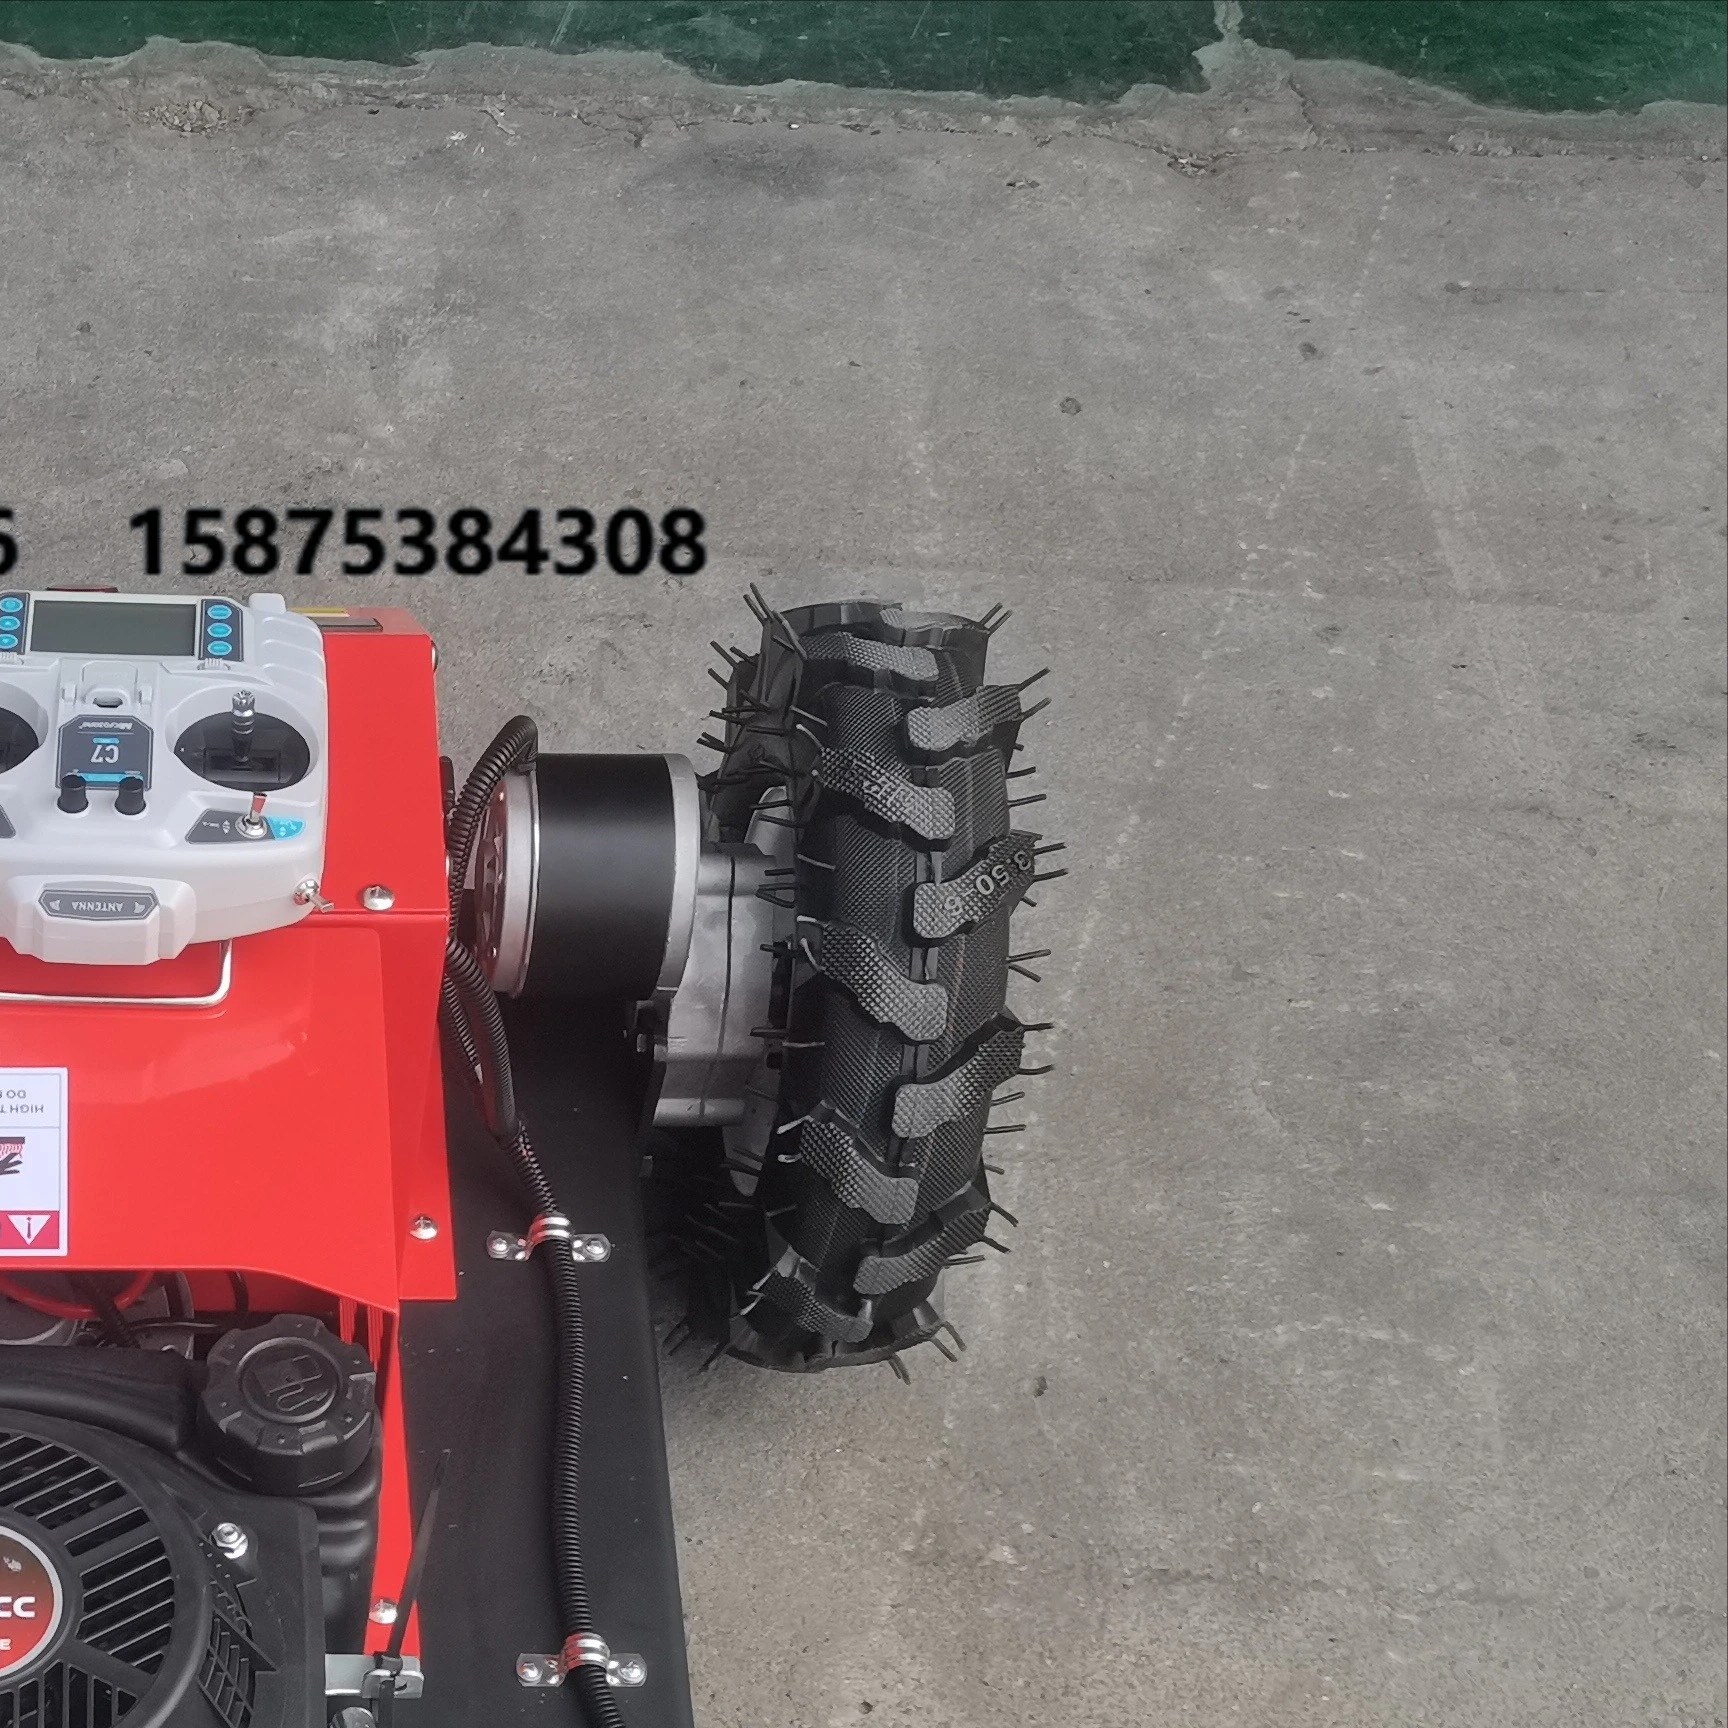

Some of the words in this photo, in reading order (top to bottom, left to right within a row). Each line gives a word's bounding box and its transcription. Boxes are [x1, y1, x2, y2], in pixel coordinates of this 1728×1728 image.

[90, 744, 119, 764] C7
[71, 901, 124, 912] ANTENNA
[6, 1089, 27, 1099] DO
[9, 1103, 45, 1114] HIGH
